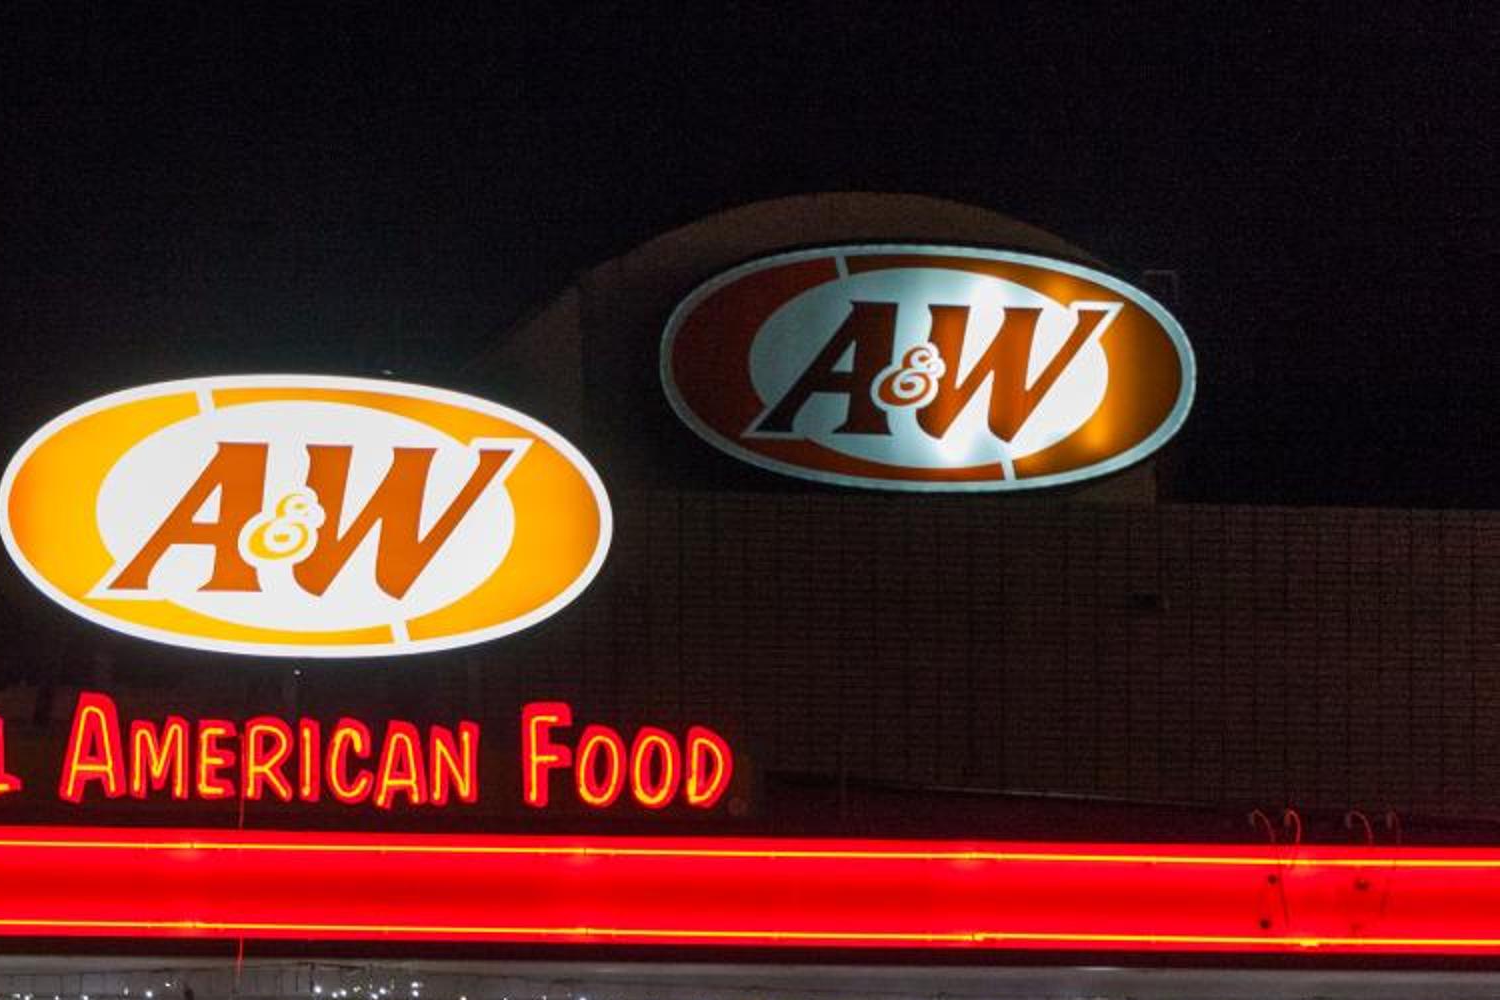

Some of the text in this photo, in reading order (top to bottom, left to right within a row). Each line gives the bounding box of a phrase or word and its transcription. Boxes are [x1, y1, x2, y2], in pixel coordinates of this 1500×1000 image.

[752, 301, 1111, 443] A&W
[106, 440, 518, 601] A&W
[58, 691, 479, 809] AMERICAN
[520, 701, 735, 809] FOOD
